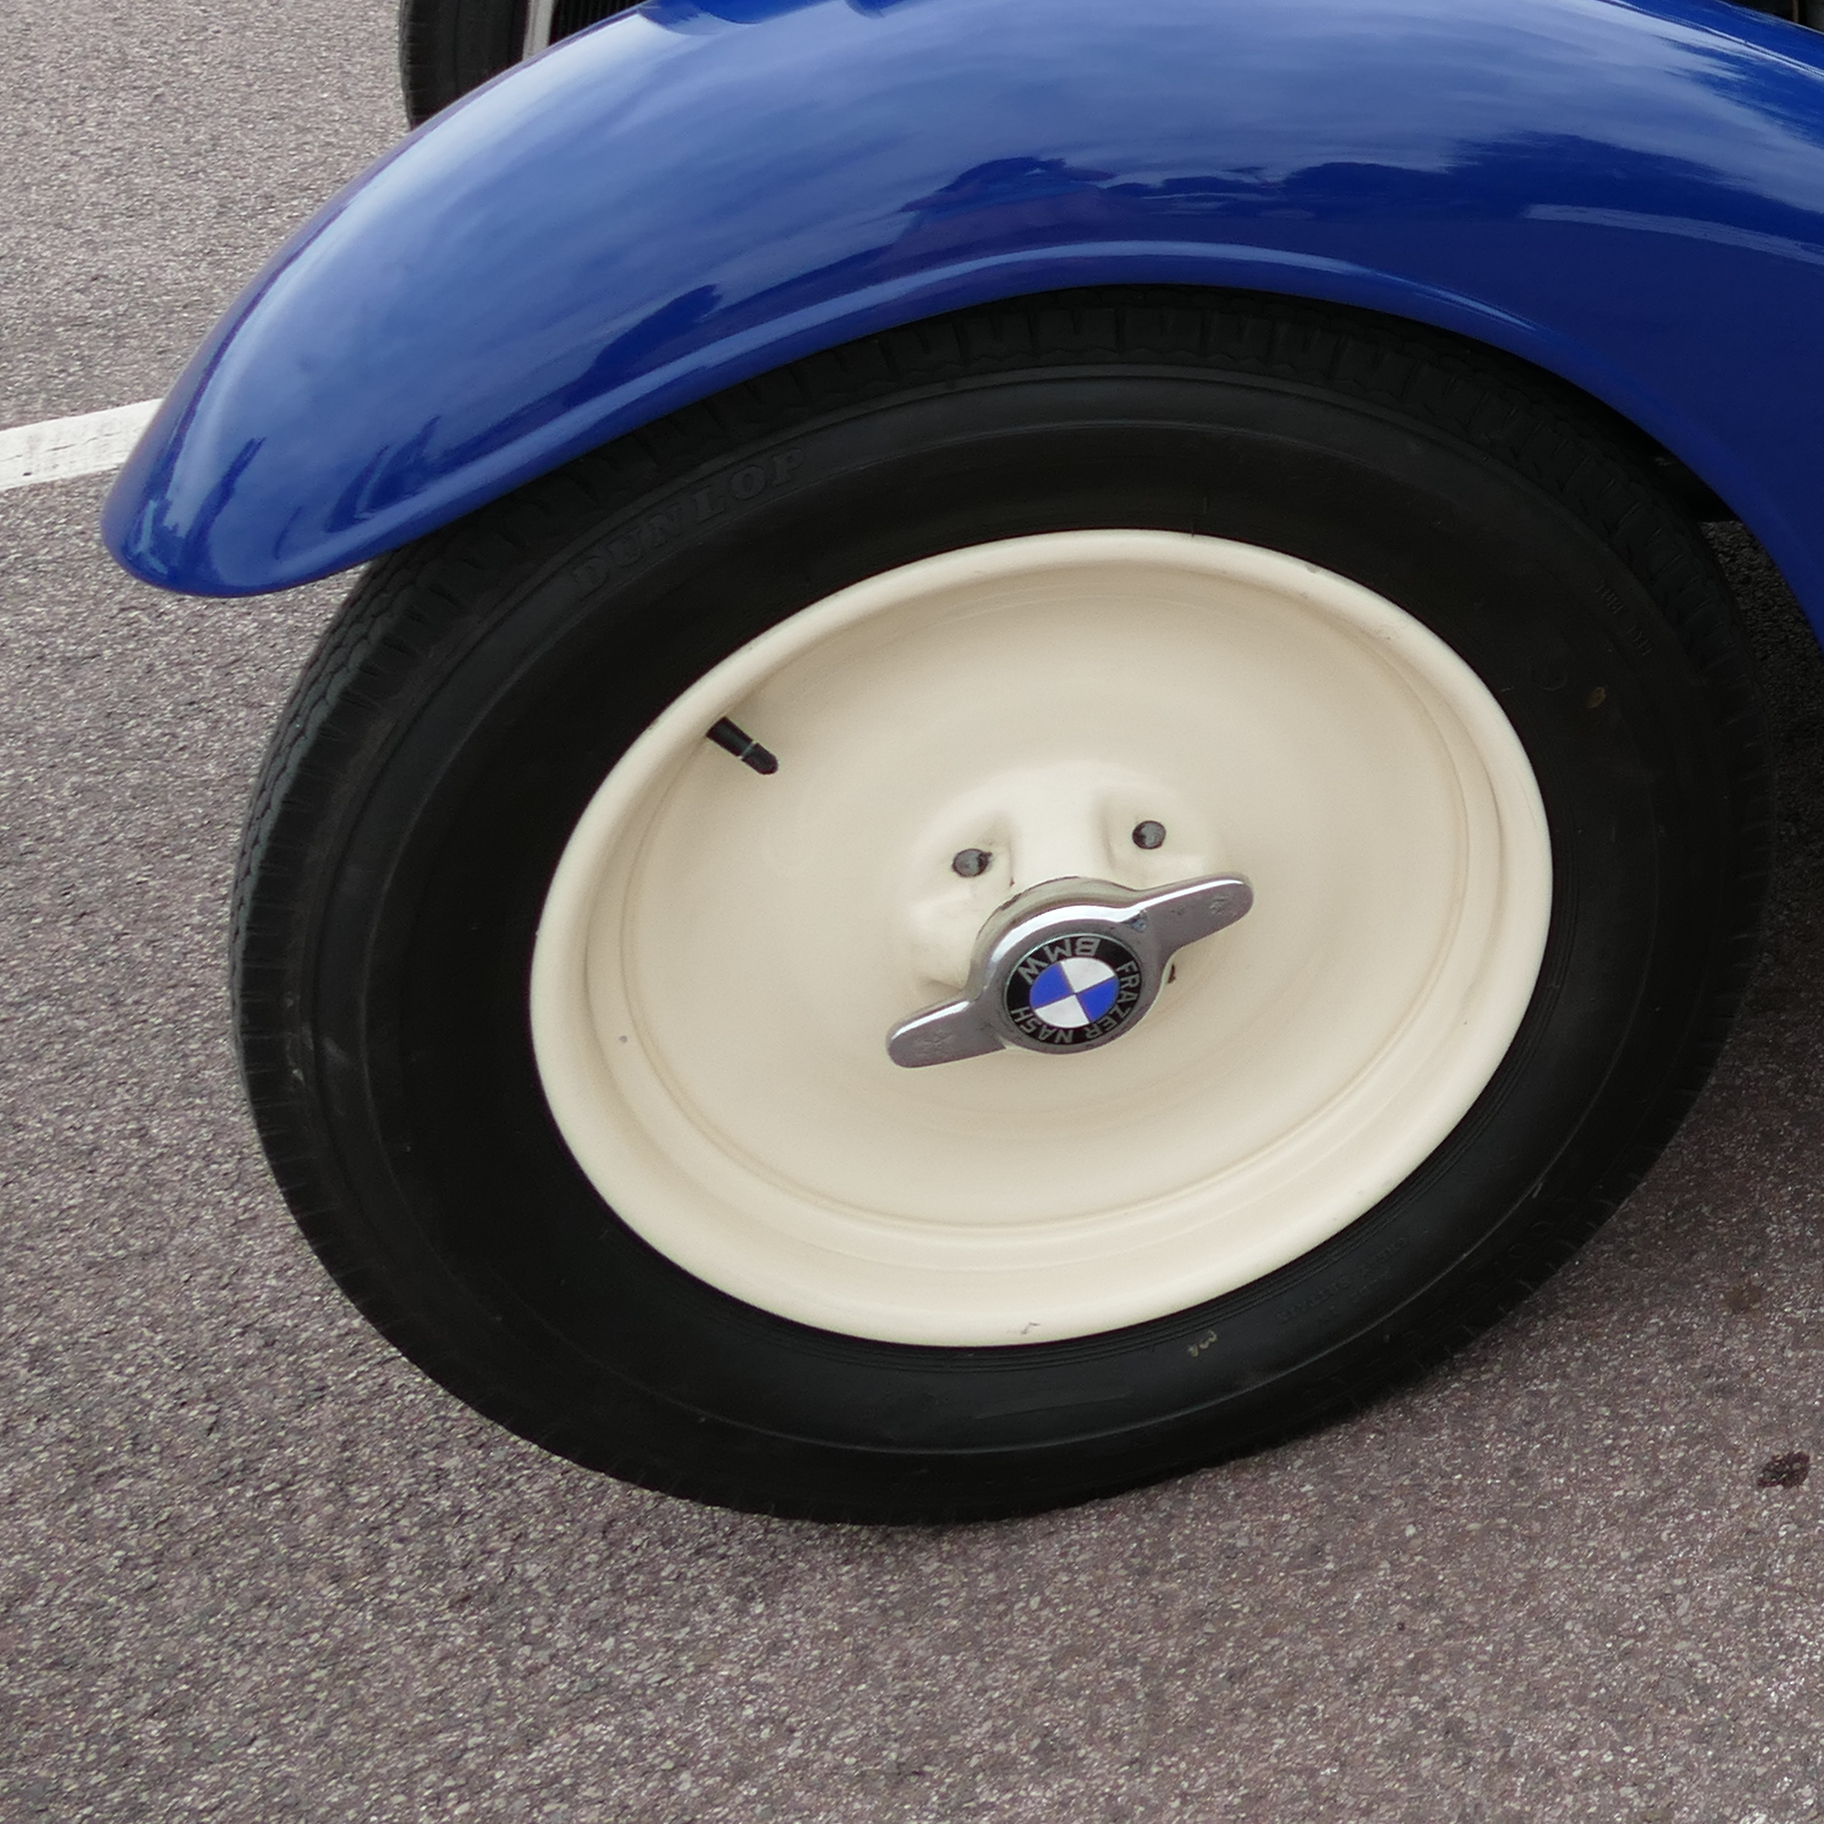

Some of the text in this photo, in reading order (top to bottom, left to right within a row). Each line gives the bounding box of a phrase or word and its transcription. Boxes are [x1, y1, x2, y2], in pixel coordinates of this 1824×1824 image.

[571, 446, 805, 604] DUNLOP
[1010, 960, 1140, 1044] FRAZER NASH
[1017, 936, 1102, 986] BMW
